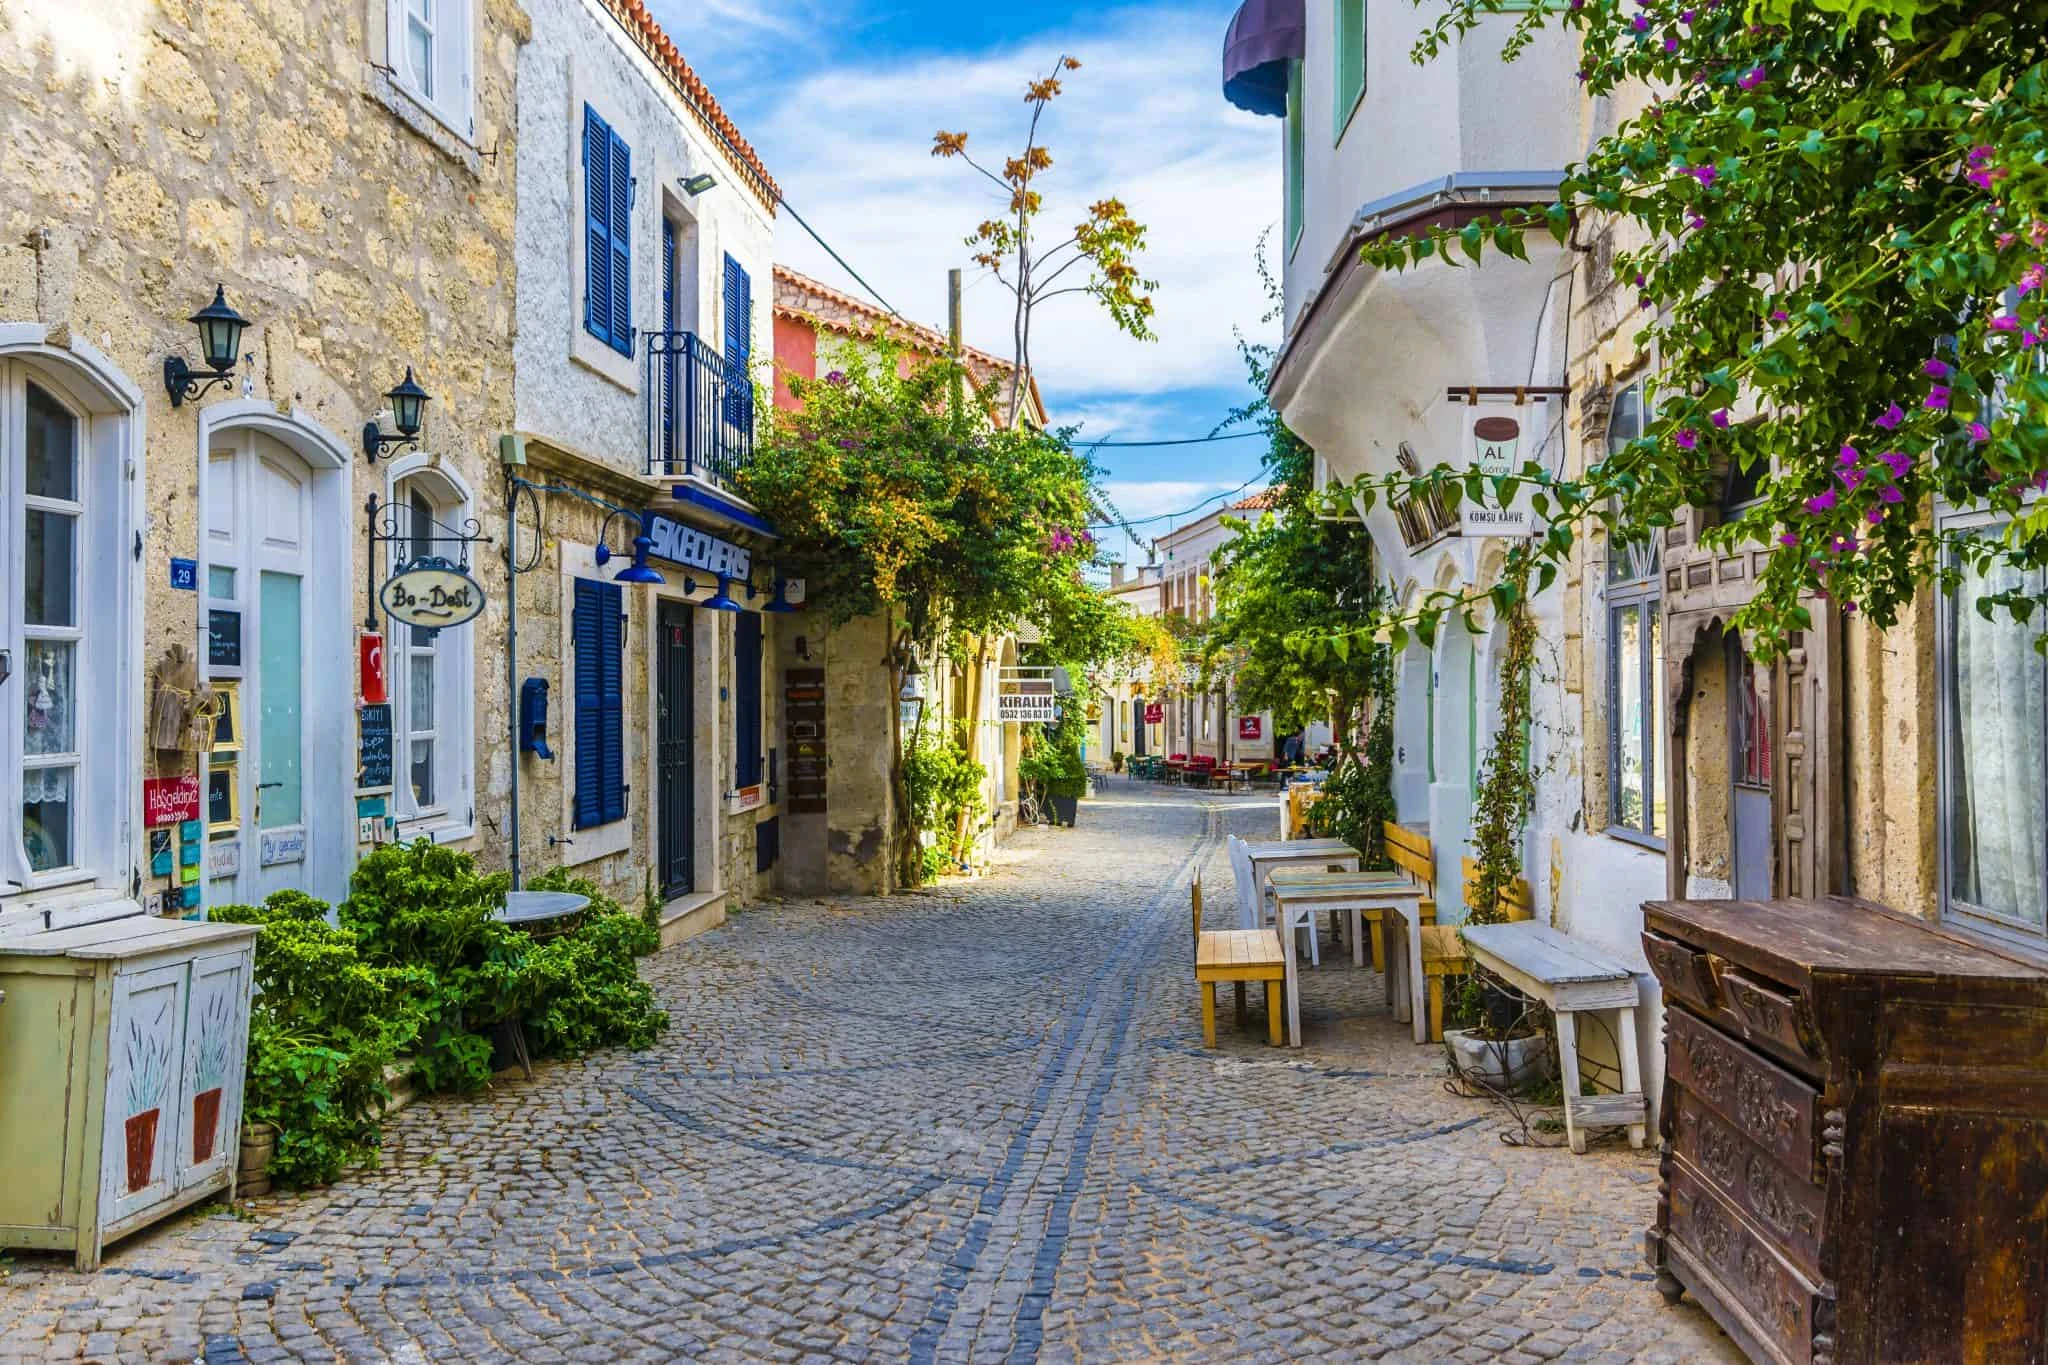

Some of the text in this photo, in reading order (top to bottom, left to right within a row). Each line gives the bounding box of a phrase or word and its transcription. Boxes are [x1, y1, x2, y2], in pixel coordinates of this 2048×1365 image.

[1484, 446, 1504, 460] AL
[1498, 511, 1524, 522] KAHVE
[648, 516, 751, 581] SKECHERS
[178, 569, 191, 584] 29
